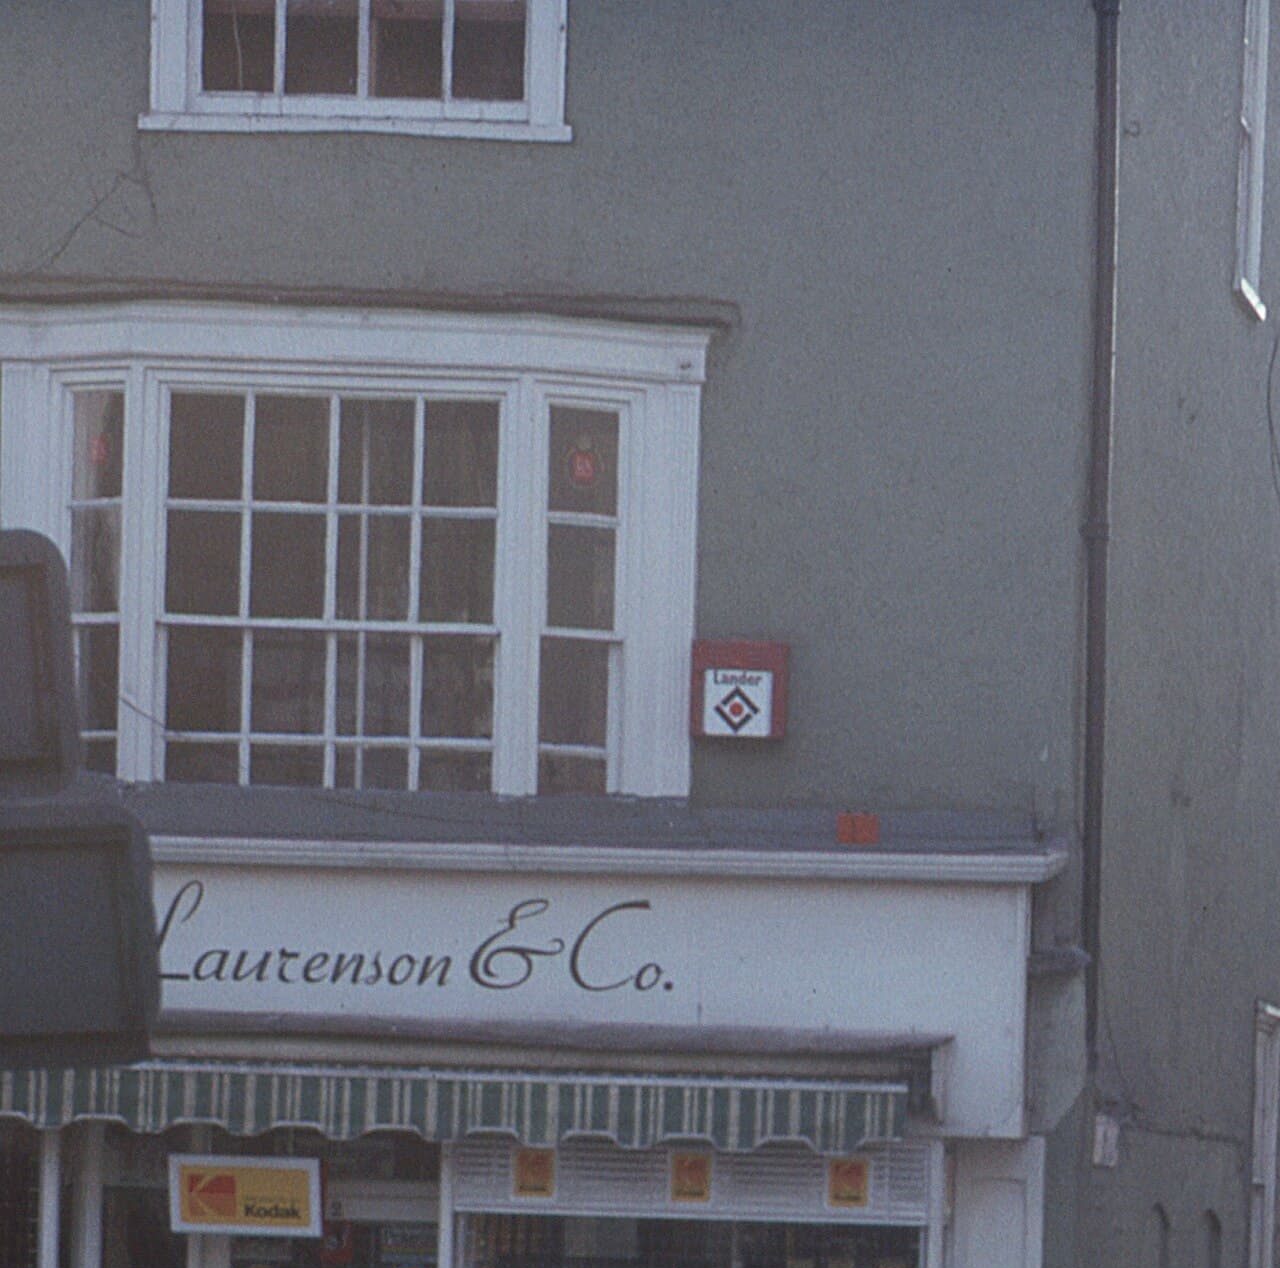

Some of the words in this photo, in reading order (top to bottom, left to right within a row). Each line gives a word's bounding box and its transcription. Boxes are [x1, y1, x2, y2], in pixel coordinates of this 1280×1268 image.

[158, 879, 451, 986] Laurenson
[469, 898, 566, 989] &
[569, 899, 675, 991] Co.
[242, 1203, 301, 1219] Kodak
